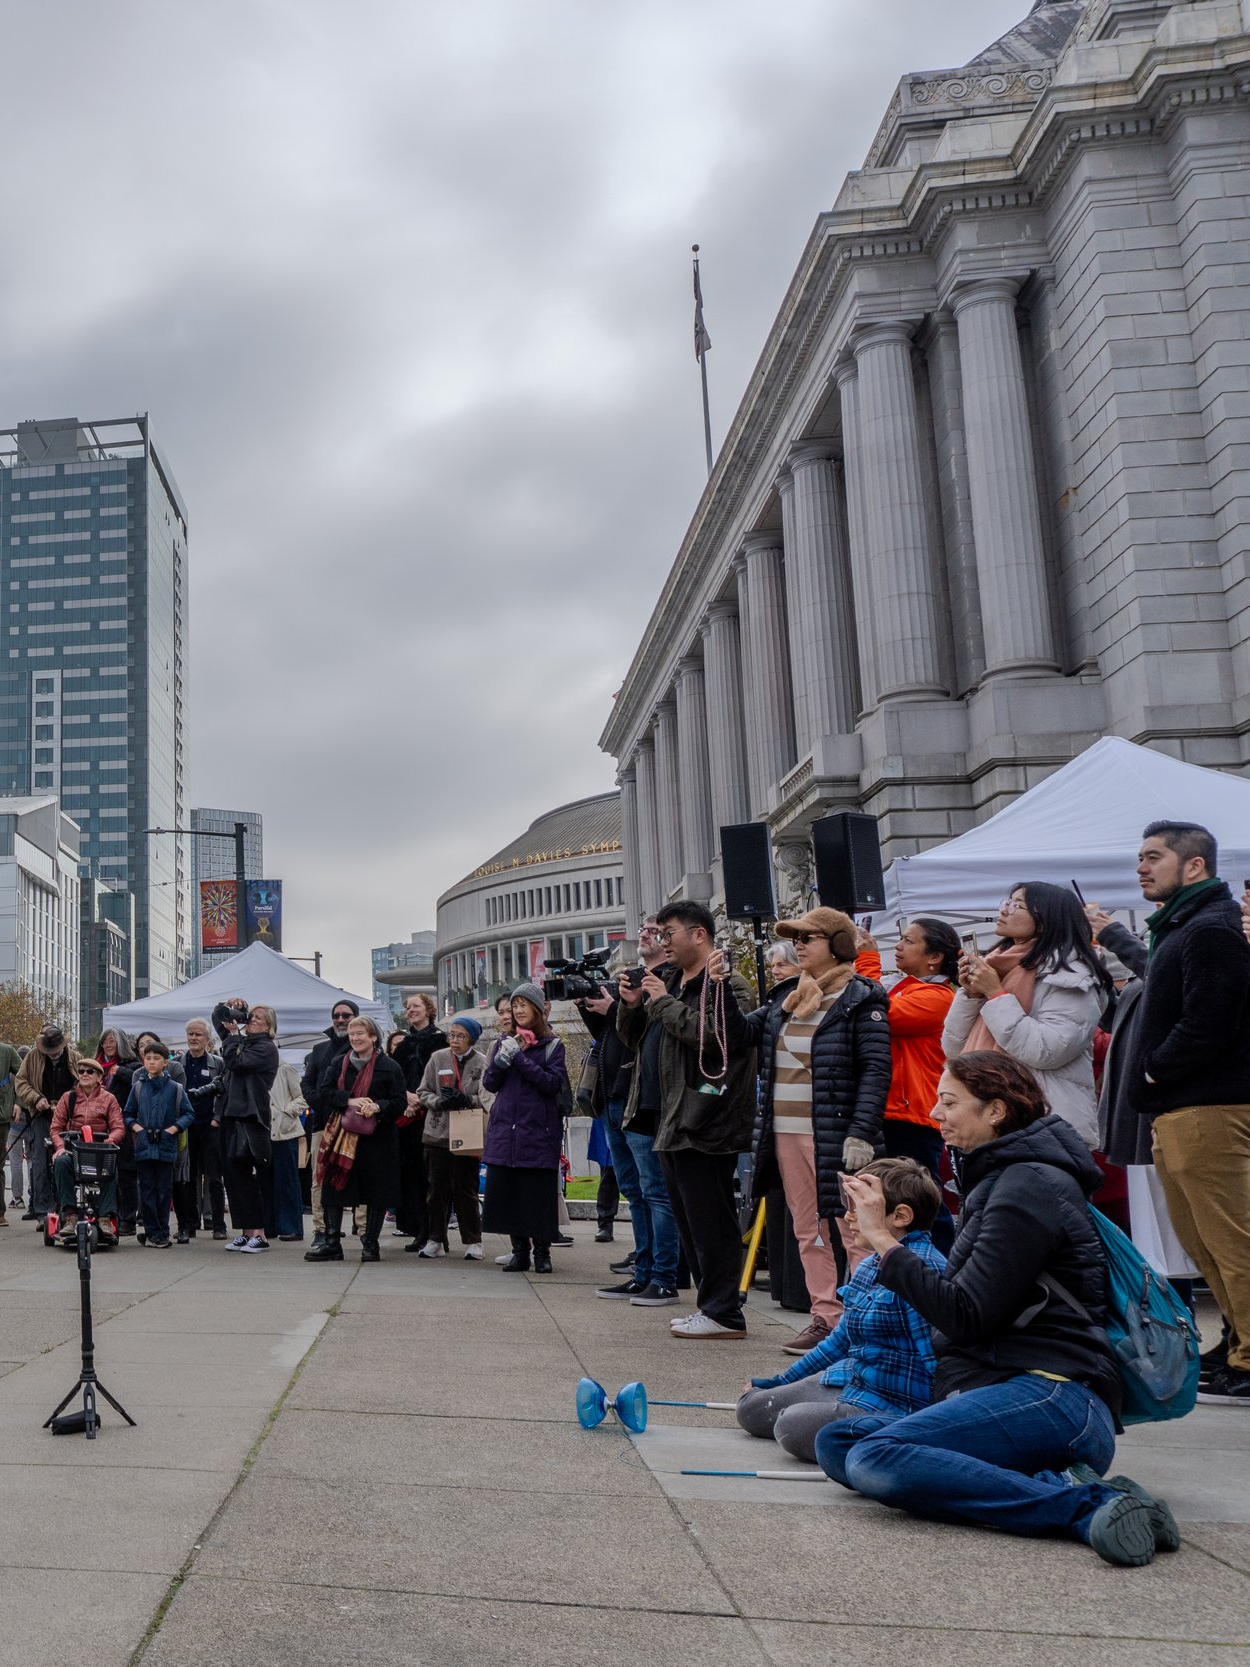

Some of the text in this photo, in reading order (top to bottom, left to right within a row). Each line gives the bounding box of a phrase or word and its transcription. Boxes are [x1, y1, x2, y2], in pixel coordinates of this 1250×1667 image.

[474, 840, 619, 878] LOUISE M DAVIES SYMP
